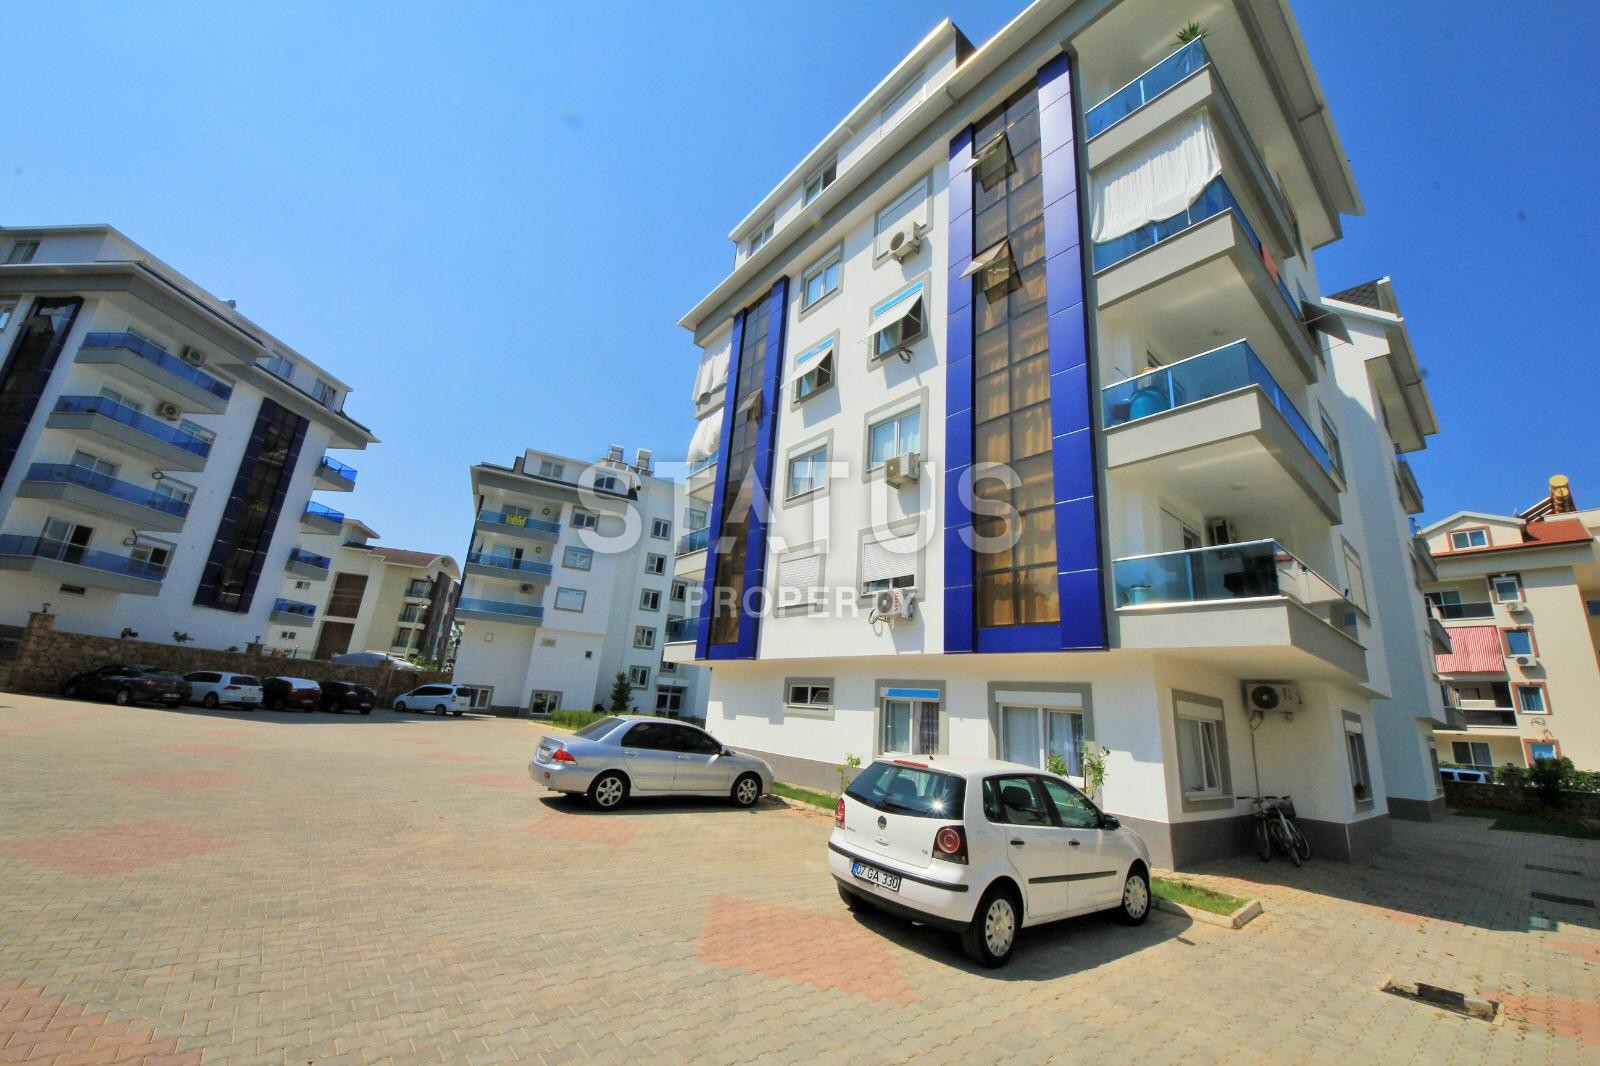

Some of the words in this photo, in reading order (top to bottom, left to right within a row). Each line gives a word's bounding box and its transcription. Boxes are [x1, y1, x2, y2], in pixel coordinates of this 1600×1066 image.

[857, 864, 866, 875] 07
[867, 868, 879, 883] GA
[882, 873, 898, 889] 330
